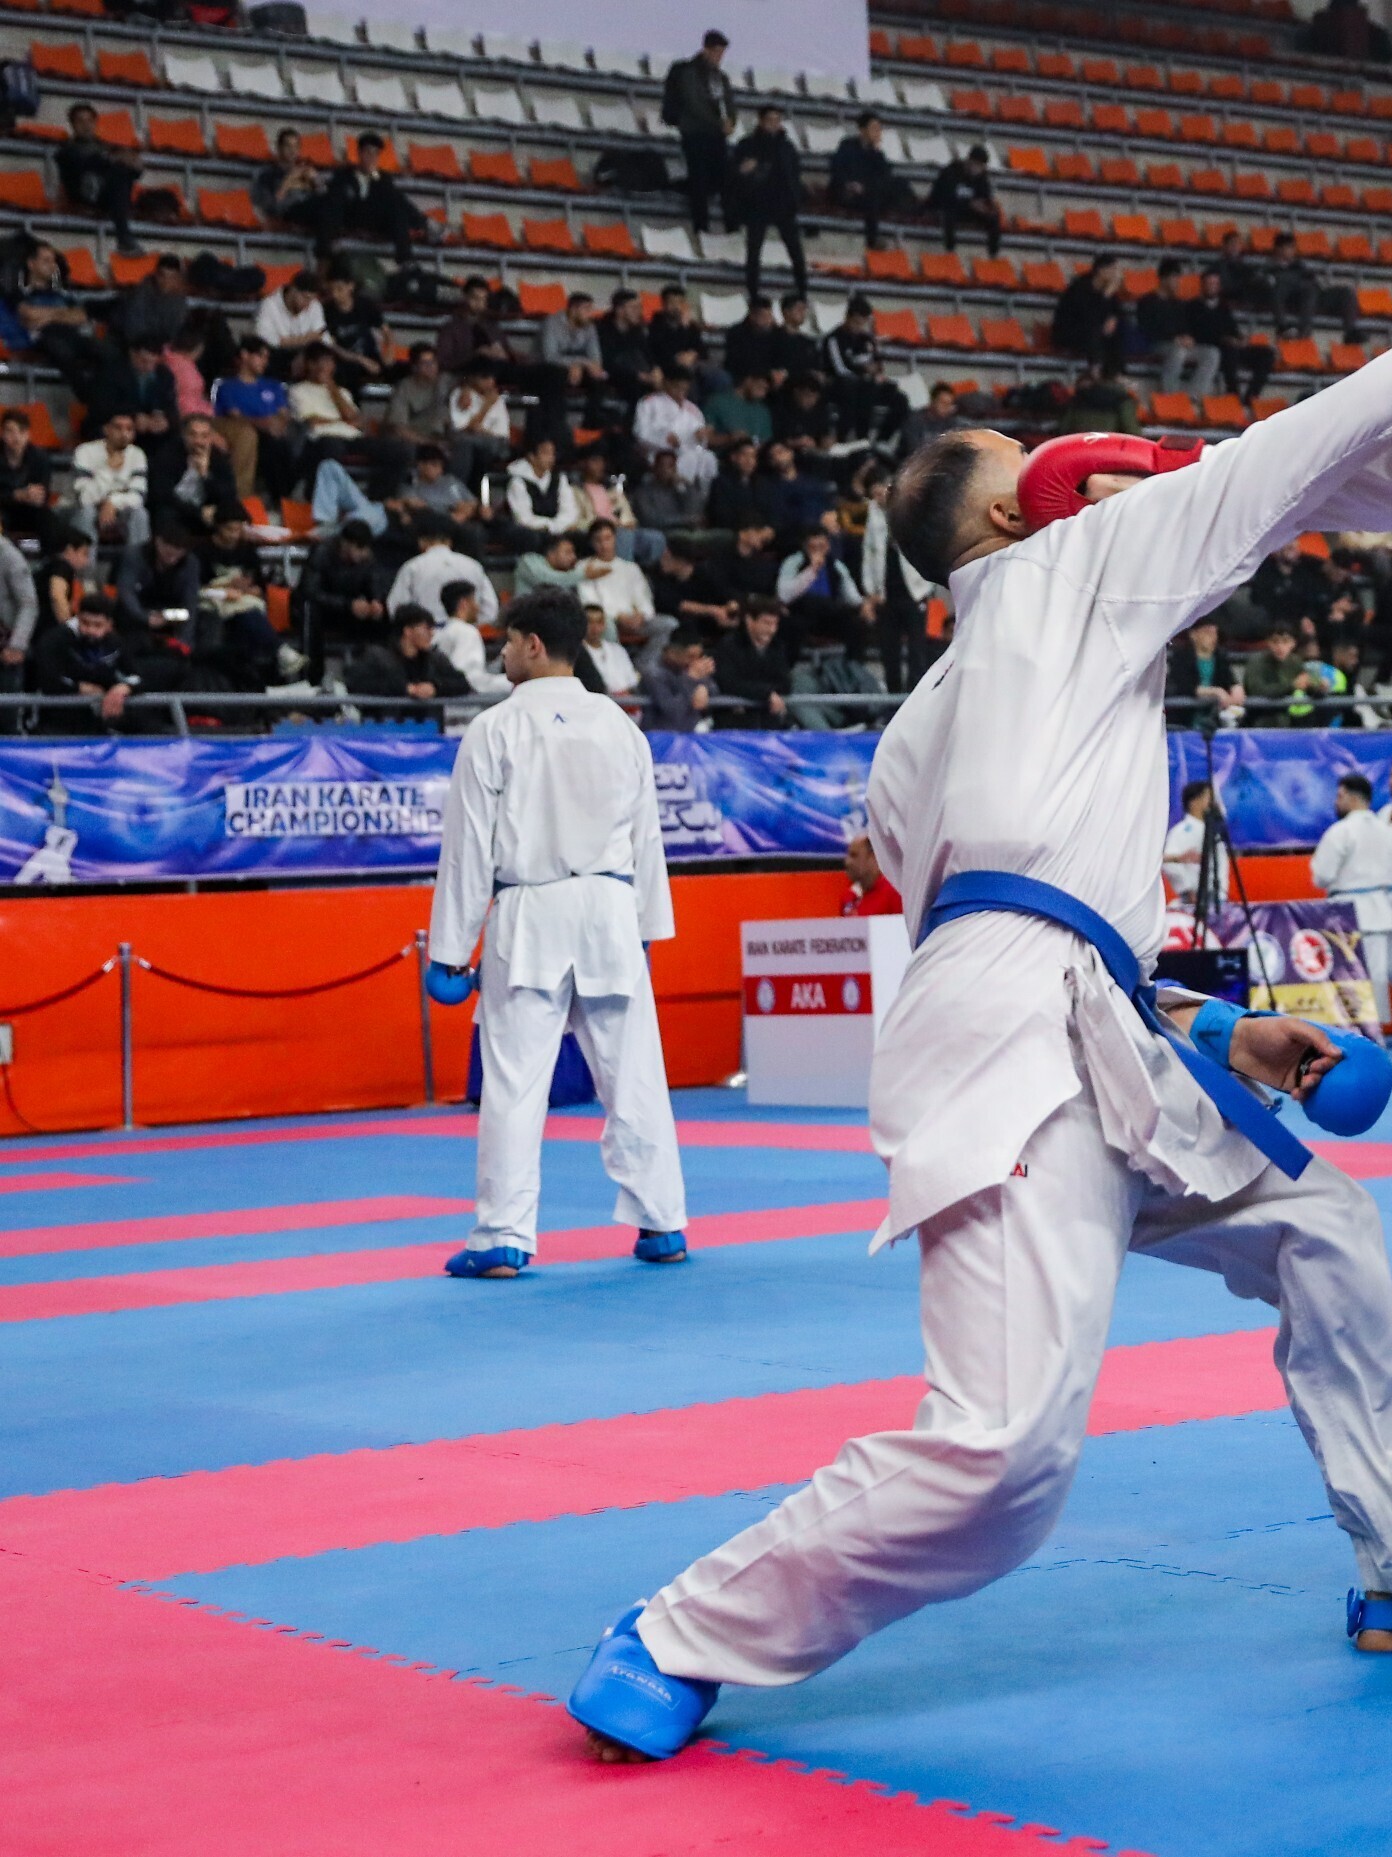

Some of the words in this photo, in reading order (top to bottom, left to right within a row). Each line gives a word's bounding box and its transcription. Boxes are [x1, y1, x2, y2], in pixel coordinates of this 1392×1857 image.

[243, 786, 309, 808] IRAN
[318, 785, 425, 808] KARATE
[790, 982, 827, 1009] AKA
